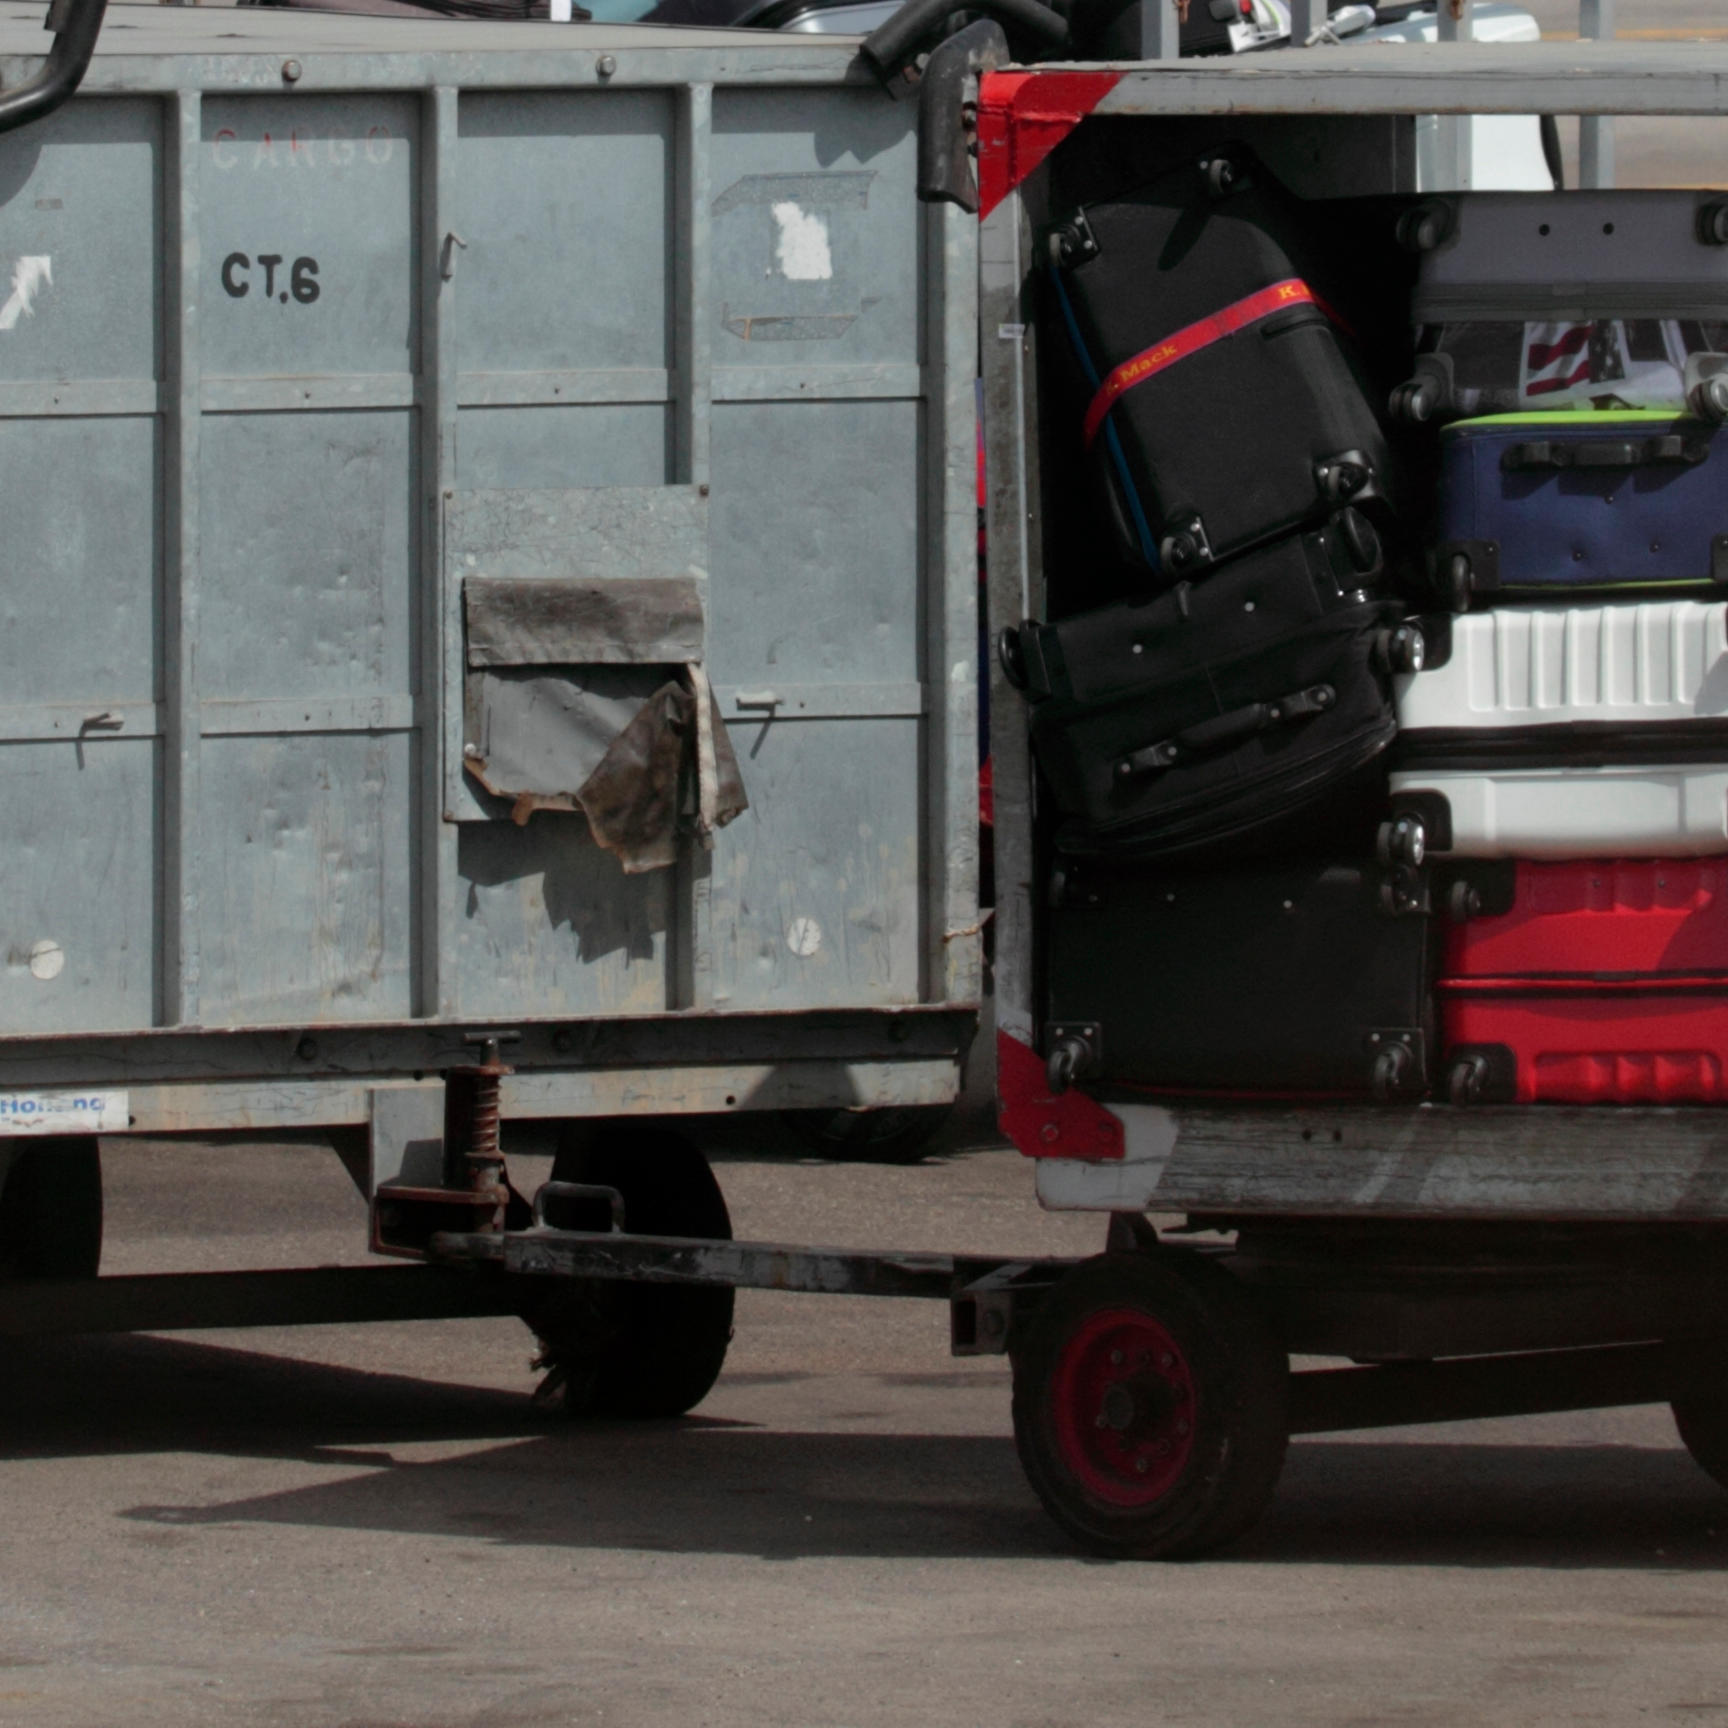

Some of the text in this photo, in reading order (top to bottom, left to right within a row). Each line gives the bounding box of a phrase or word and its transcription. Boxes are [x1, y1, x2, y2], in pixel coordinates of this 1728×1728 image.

[212, 125, 393, 170] CARGO
[221, 251, 320, 304] CT.6
[1119, 343, 1178, 382] Mack
